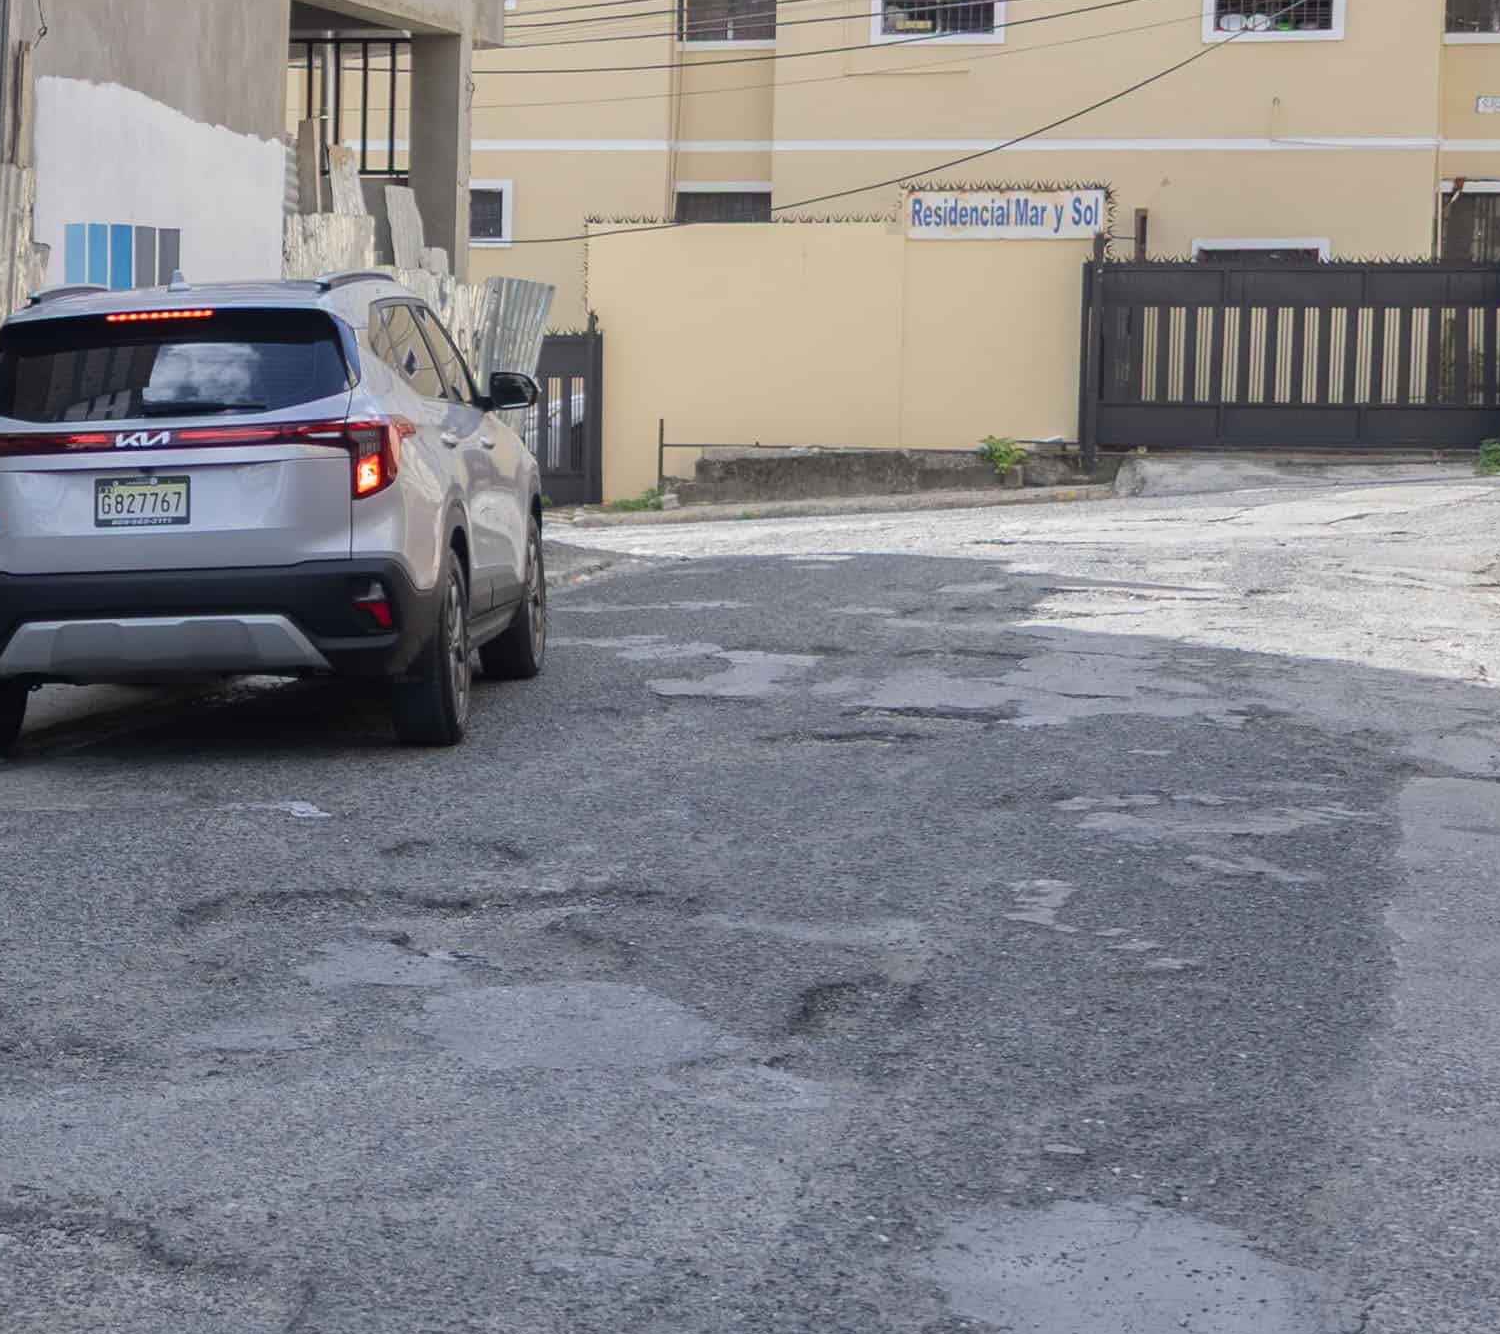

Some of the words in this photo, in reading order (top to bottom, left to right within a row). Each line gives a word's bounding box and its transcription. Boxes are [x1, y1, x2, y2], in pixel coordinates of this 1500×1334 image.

[911, 198, 1010, 228] Residencial
[1014, 198, 1047, 227] Mar
[1052, 204, 1065, 234] y
[1071, 196, 1099, 226] Sol
[116, 431, 170, 447] KIA
[102, 492, 181, 514] G827767
